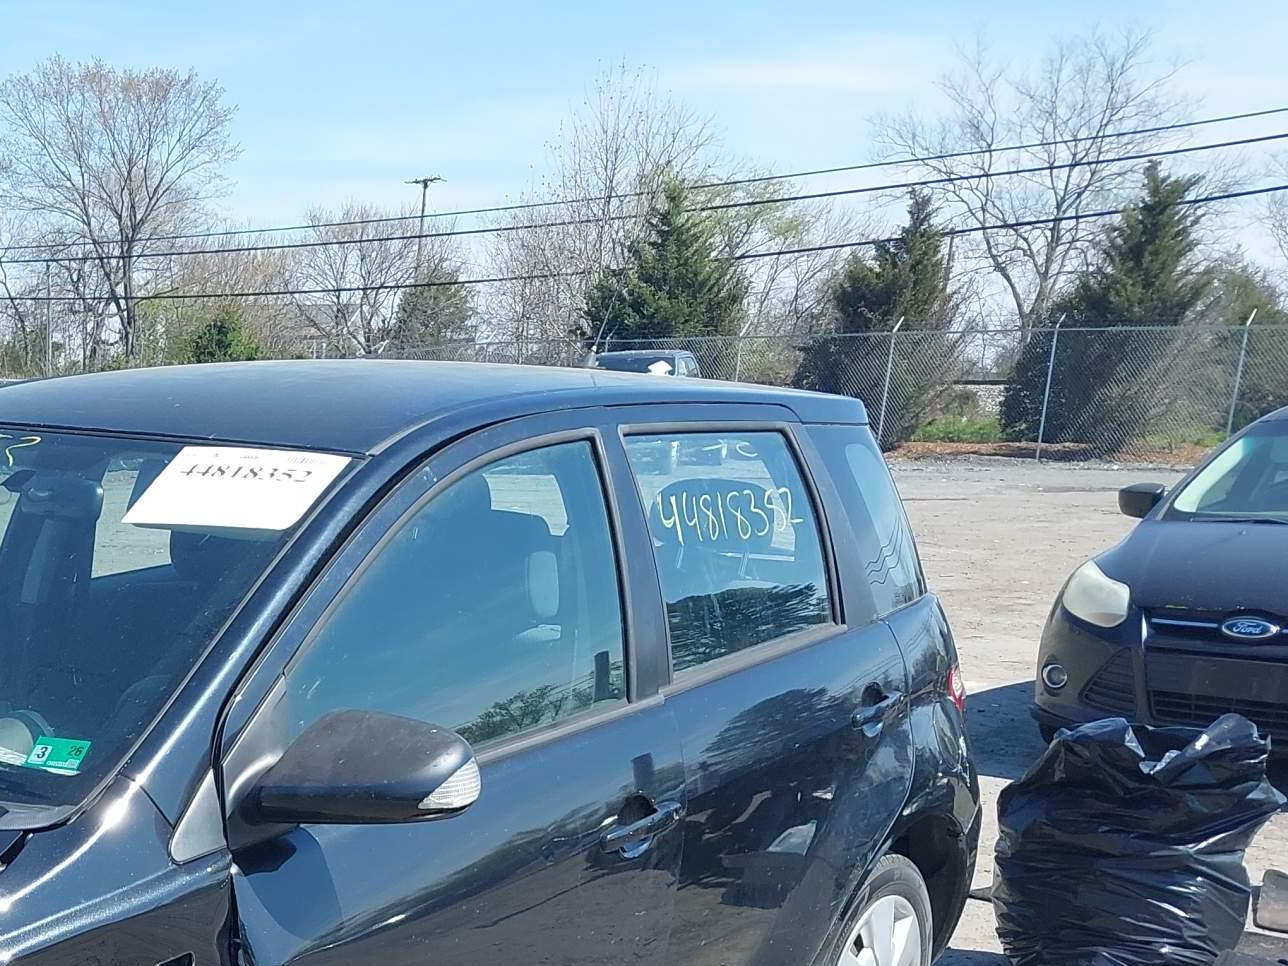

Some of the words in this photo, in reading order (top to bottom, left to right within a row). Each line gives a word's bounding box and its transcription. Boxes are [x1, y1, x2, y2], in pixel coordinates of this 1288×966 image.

[180, 463, 313, 482] 44818352
[655, 487, 804, 545] 44818352
[1232, 621, 1263, 634] Ford
[37, 746, 48, 758] 3
[67, 745, 84, 757] 26
